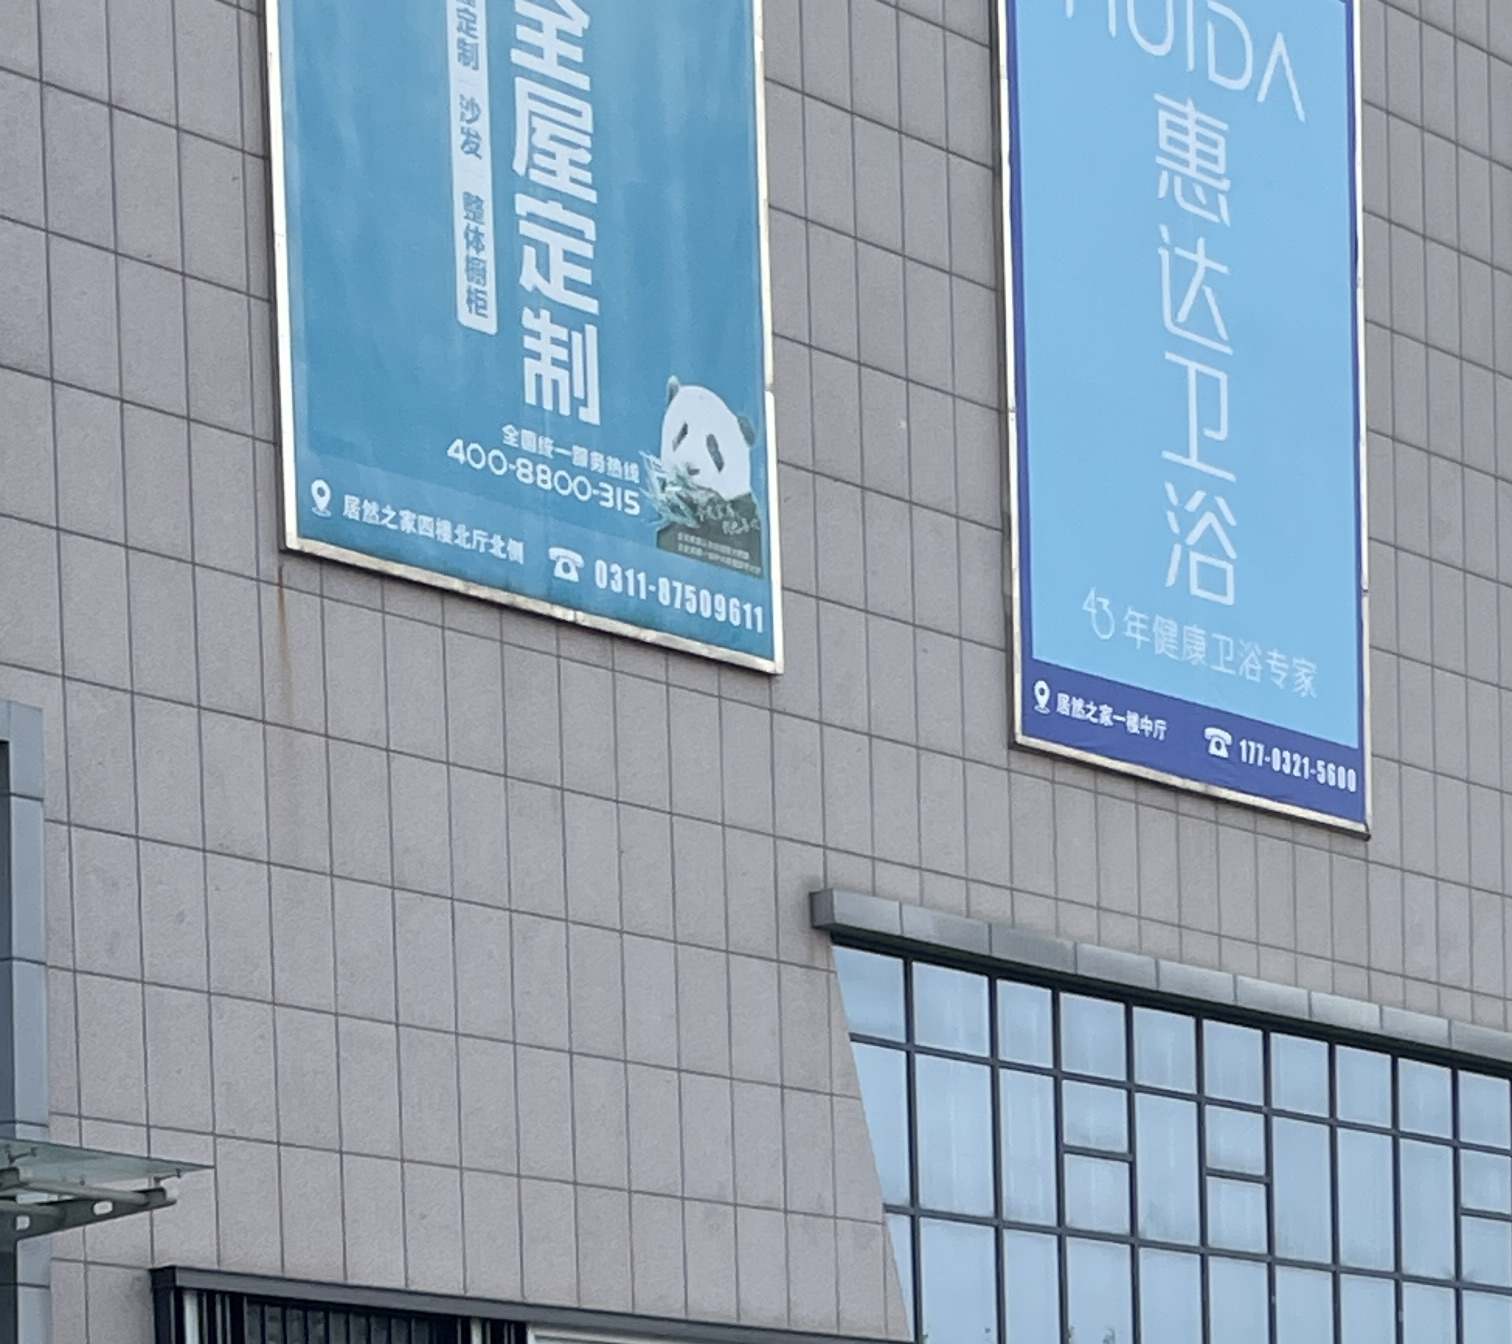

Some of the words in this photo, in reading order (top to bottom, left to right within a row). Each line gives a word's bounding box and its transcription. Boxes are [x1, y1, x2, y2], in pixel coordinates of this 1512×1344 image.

[454, 0, 480, 71] 定制
[511, 0, 600, 425] 全屋定制
[1153, 93, 1237, 606] 惠达卫浴
[447, 438, 641, 516] 400-8800-315
[594, 559, 764, 633] 0311-87509611
